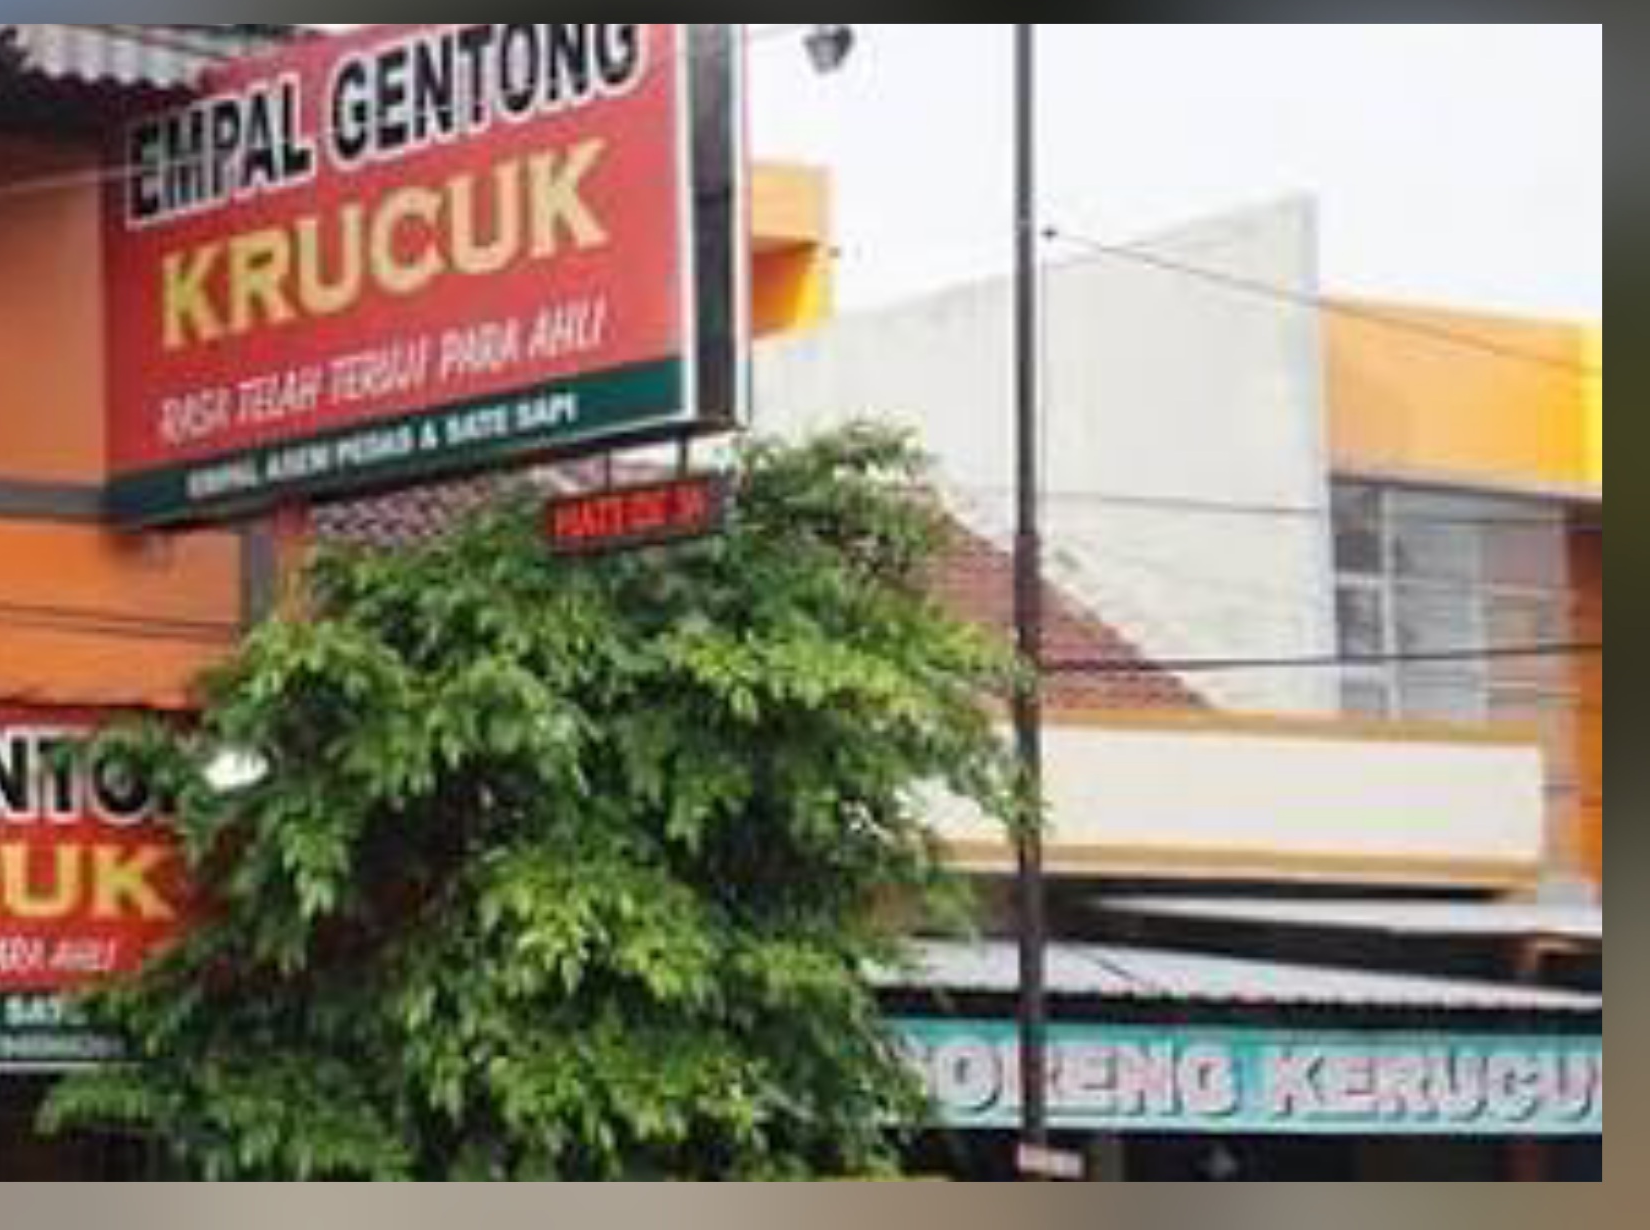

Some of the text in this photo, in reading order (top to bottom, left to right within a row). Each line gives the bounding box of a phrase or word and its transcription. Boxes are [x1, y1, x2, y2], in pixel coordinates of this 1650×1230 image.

[128, 24, 641, 225] EMPAL GENTONG
[160, 137, 609, 350] KRUCUK
[161, 386, 231, 444] RASA
[238, 363, 323, 423] TELAH
[439, 316, 520, 381] PARA
[527, 295, 608, 360] AHLI
[3, 994, 88, 1026] SAT
[1272, 1046, 1600, 1121] KERUCU
